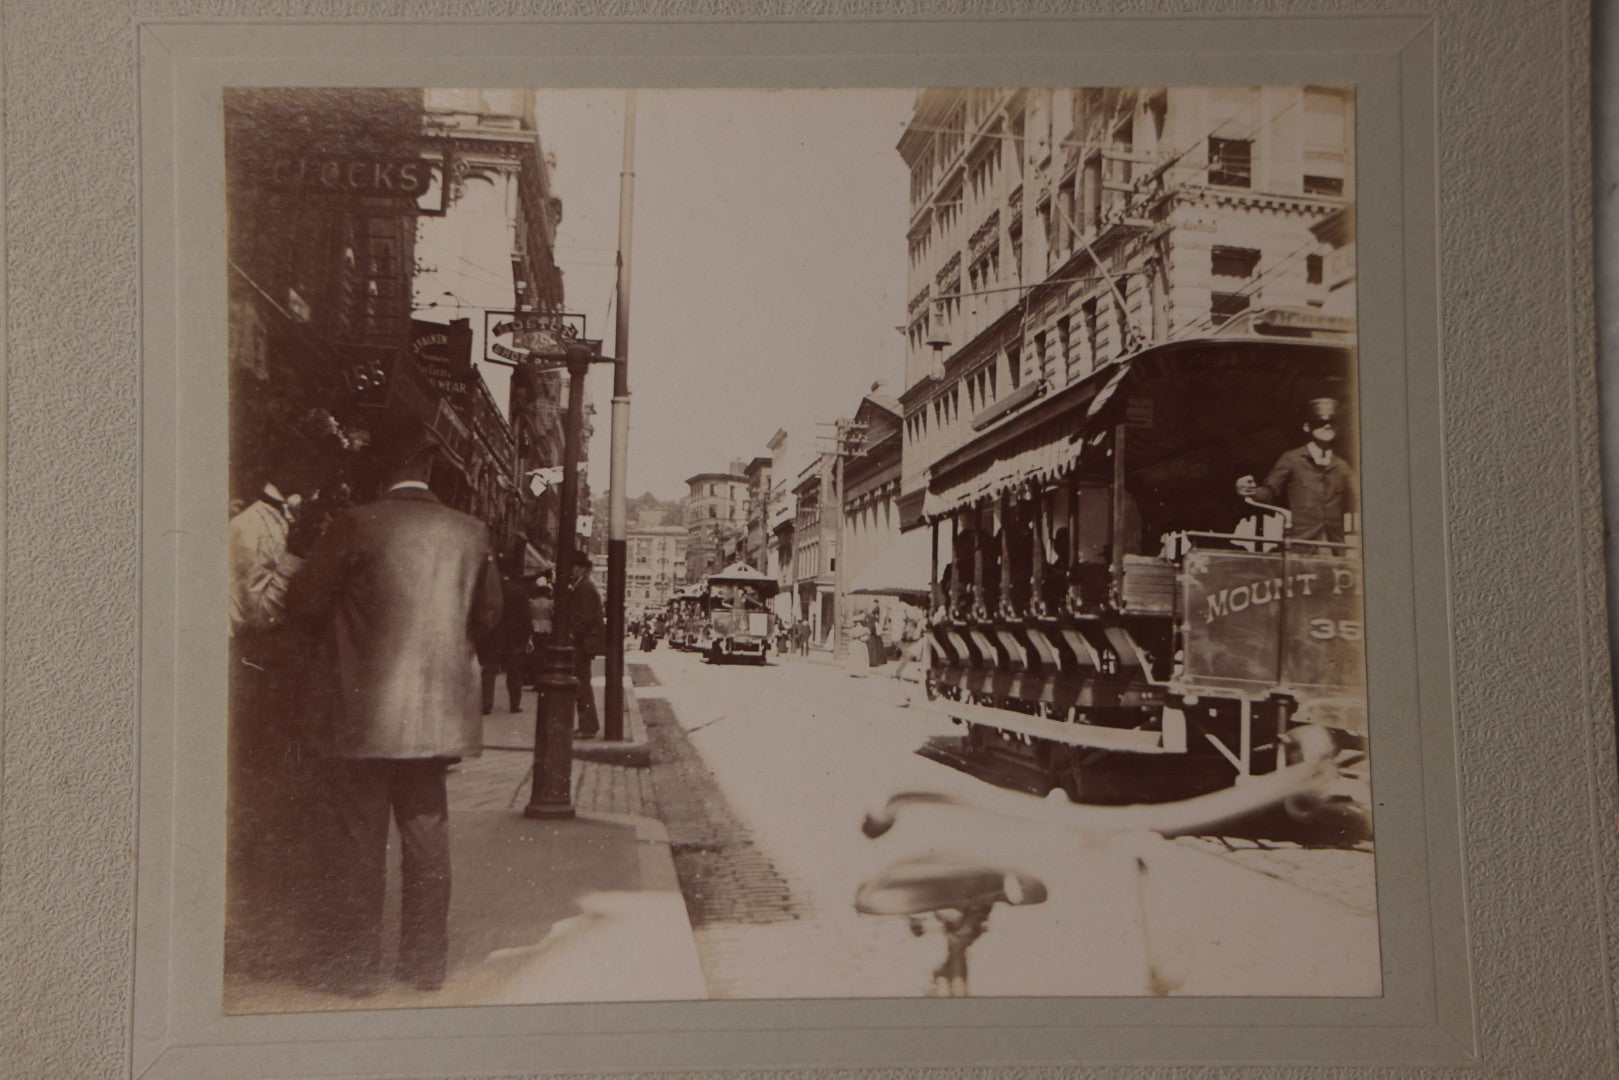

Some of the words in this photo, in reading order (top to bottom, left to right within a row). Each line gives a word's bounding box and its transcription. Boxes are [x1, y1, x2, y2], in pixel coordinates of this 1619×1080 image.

[494, 345, 528, 363] SHOE
[1206, 574, 1317, 624] MOUNT
[1310, 618, 1362, 641] 35
